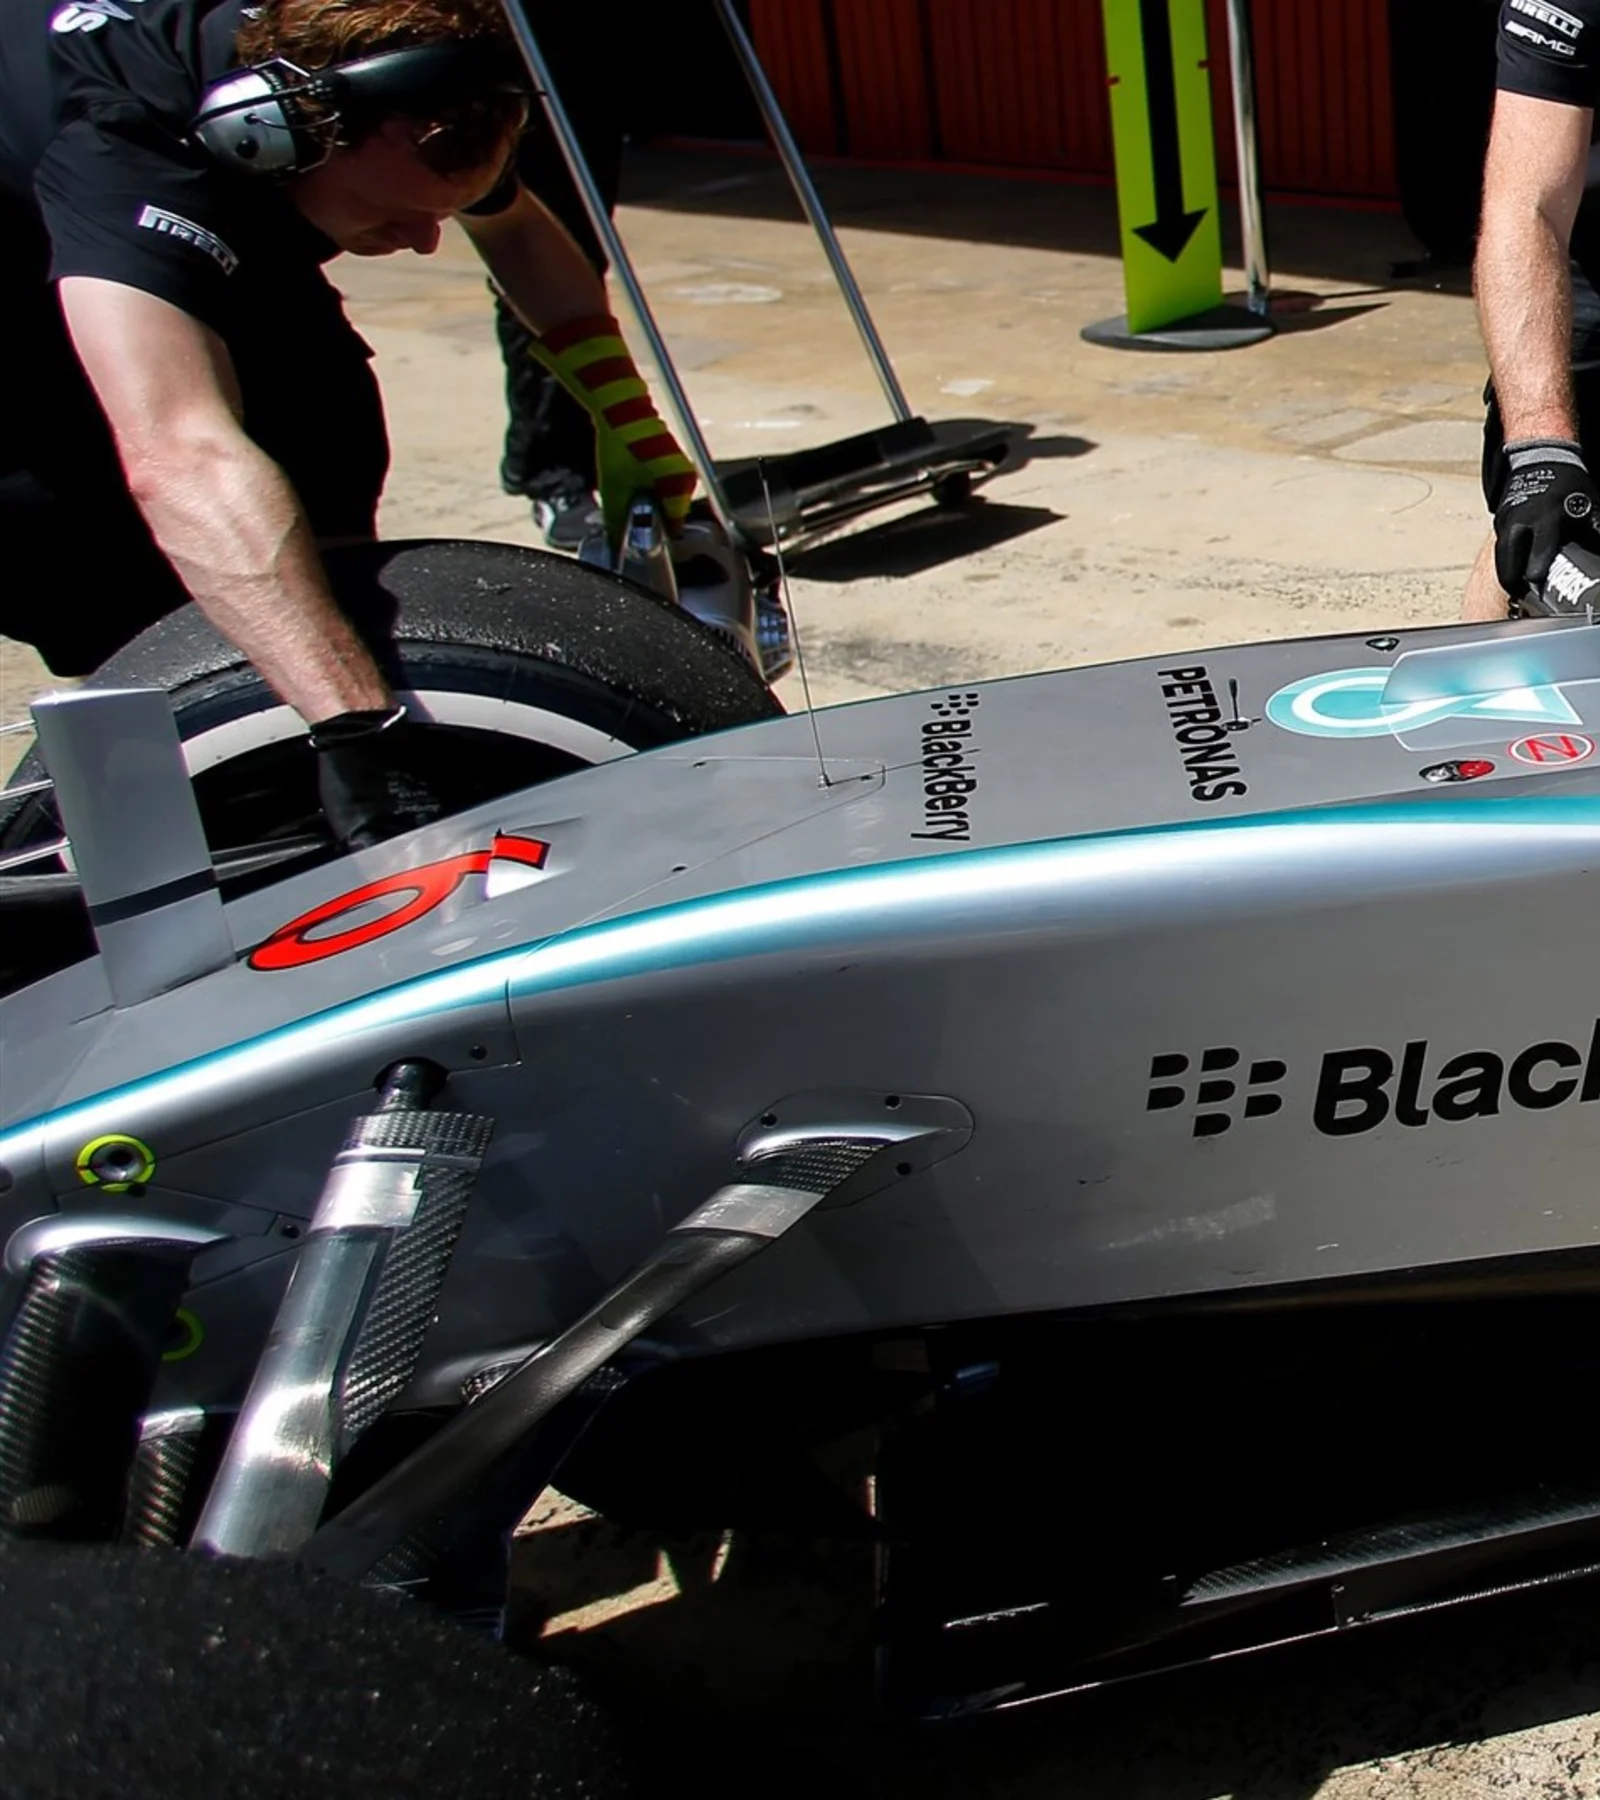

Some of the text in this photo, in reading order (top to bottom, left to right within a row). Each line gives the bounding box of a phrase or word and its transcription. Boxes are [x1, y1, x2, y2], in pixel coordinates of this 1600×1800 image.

[138, 204, 239, 276] PIRELLI
[910, 718, 977, 842] BlackBerry
[1157, 665, 1248, 803] PETRONAS
